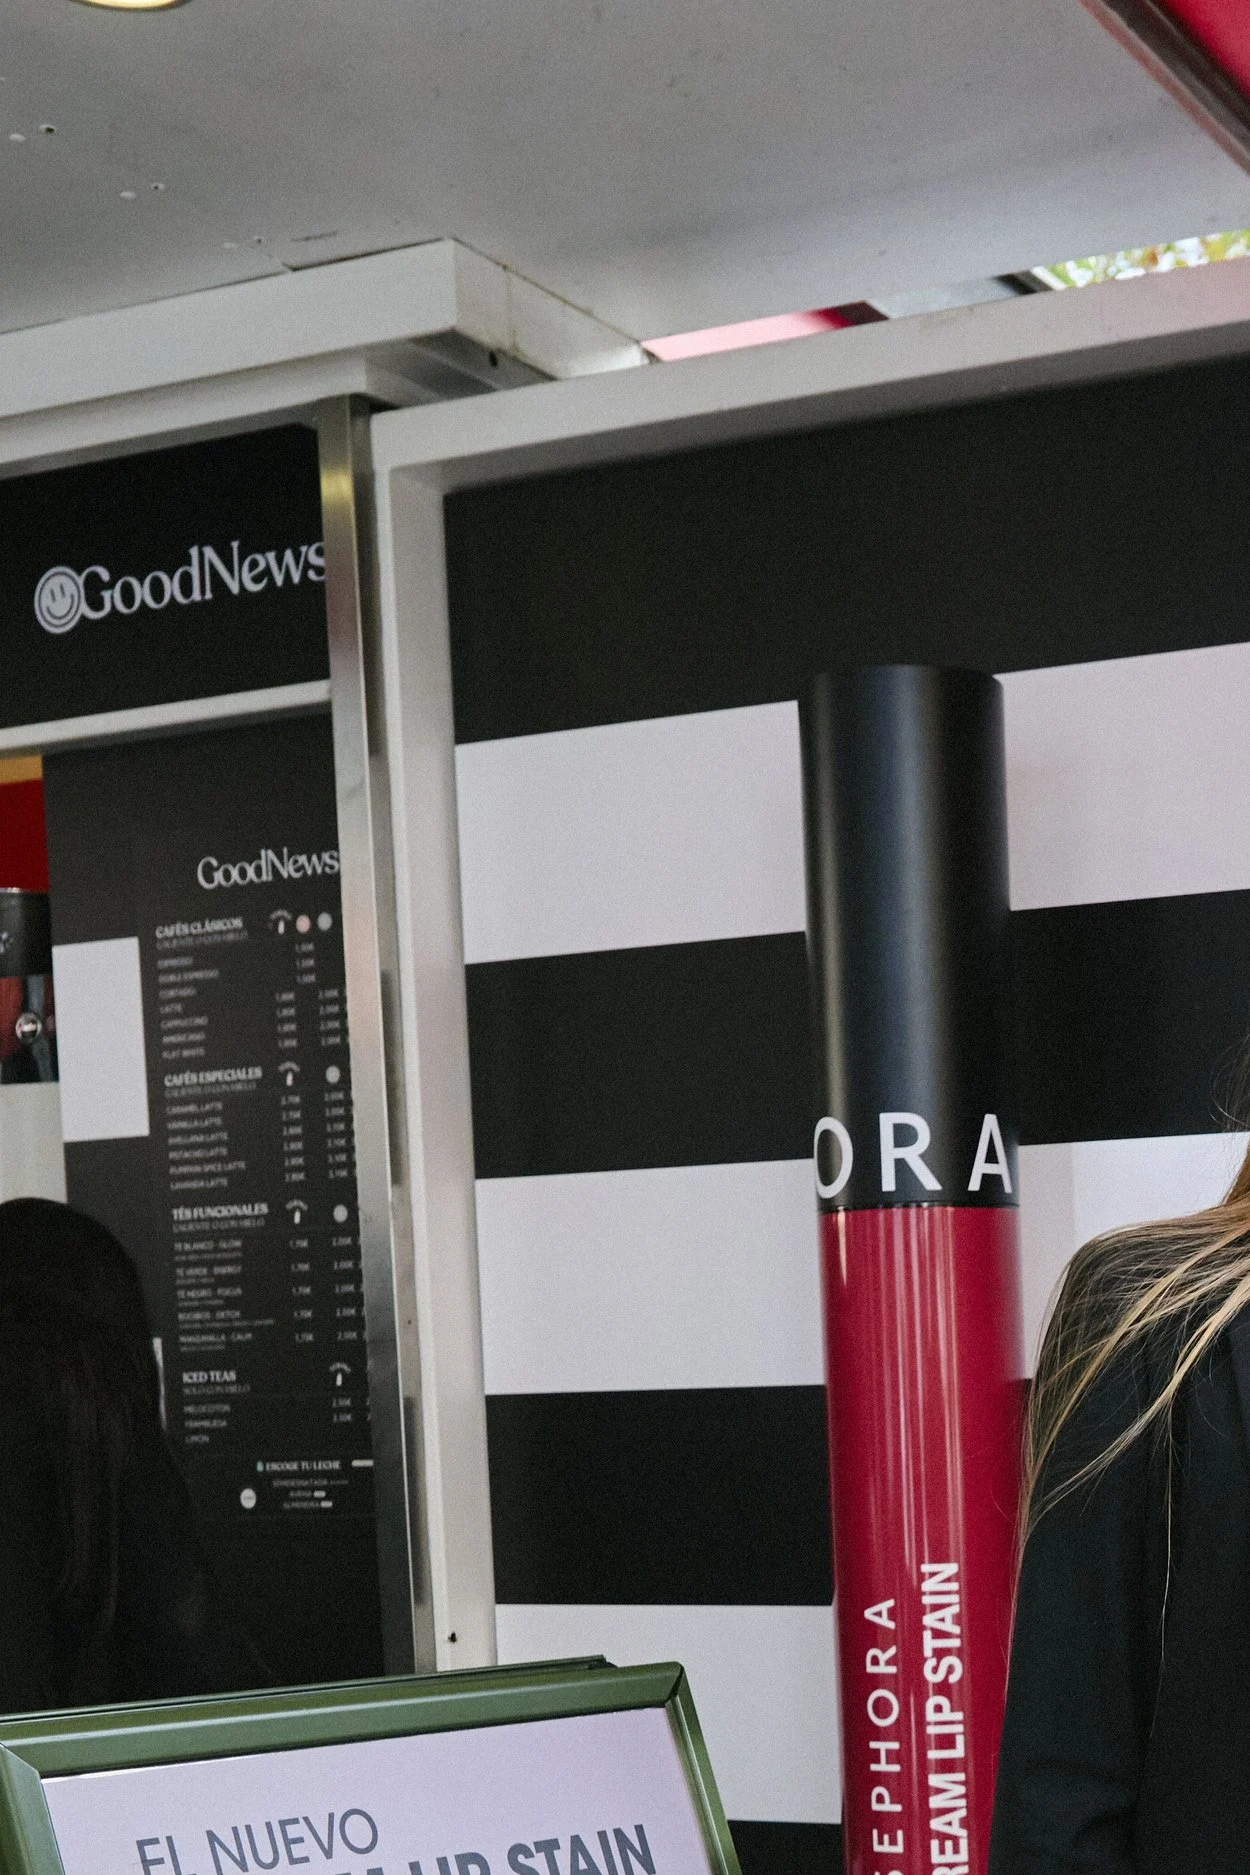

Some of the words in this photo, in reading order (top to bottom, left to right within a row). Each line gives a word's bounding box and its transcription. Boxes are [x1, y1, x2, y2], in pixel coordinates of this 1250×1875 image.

[78, 540, 326, 620] GoodNews
[197, 846, 340, 890] GoodNews
[921, 1562, 963, 1686] STAIN
[925, 1692, 966, 1764] LIP
